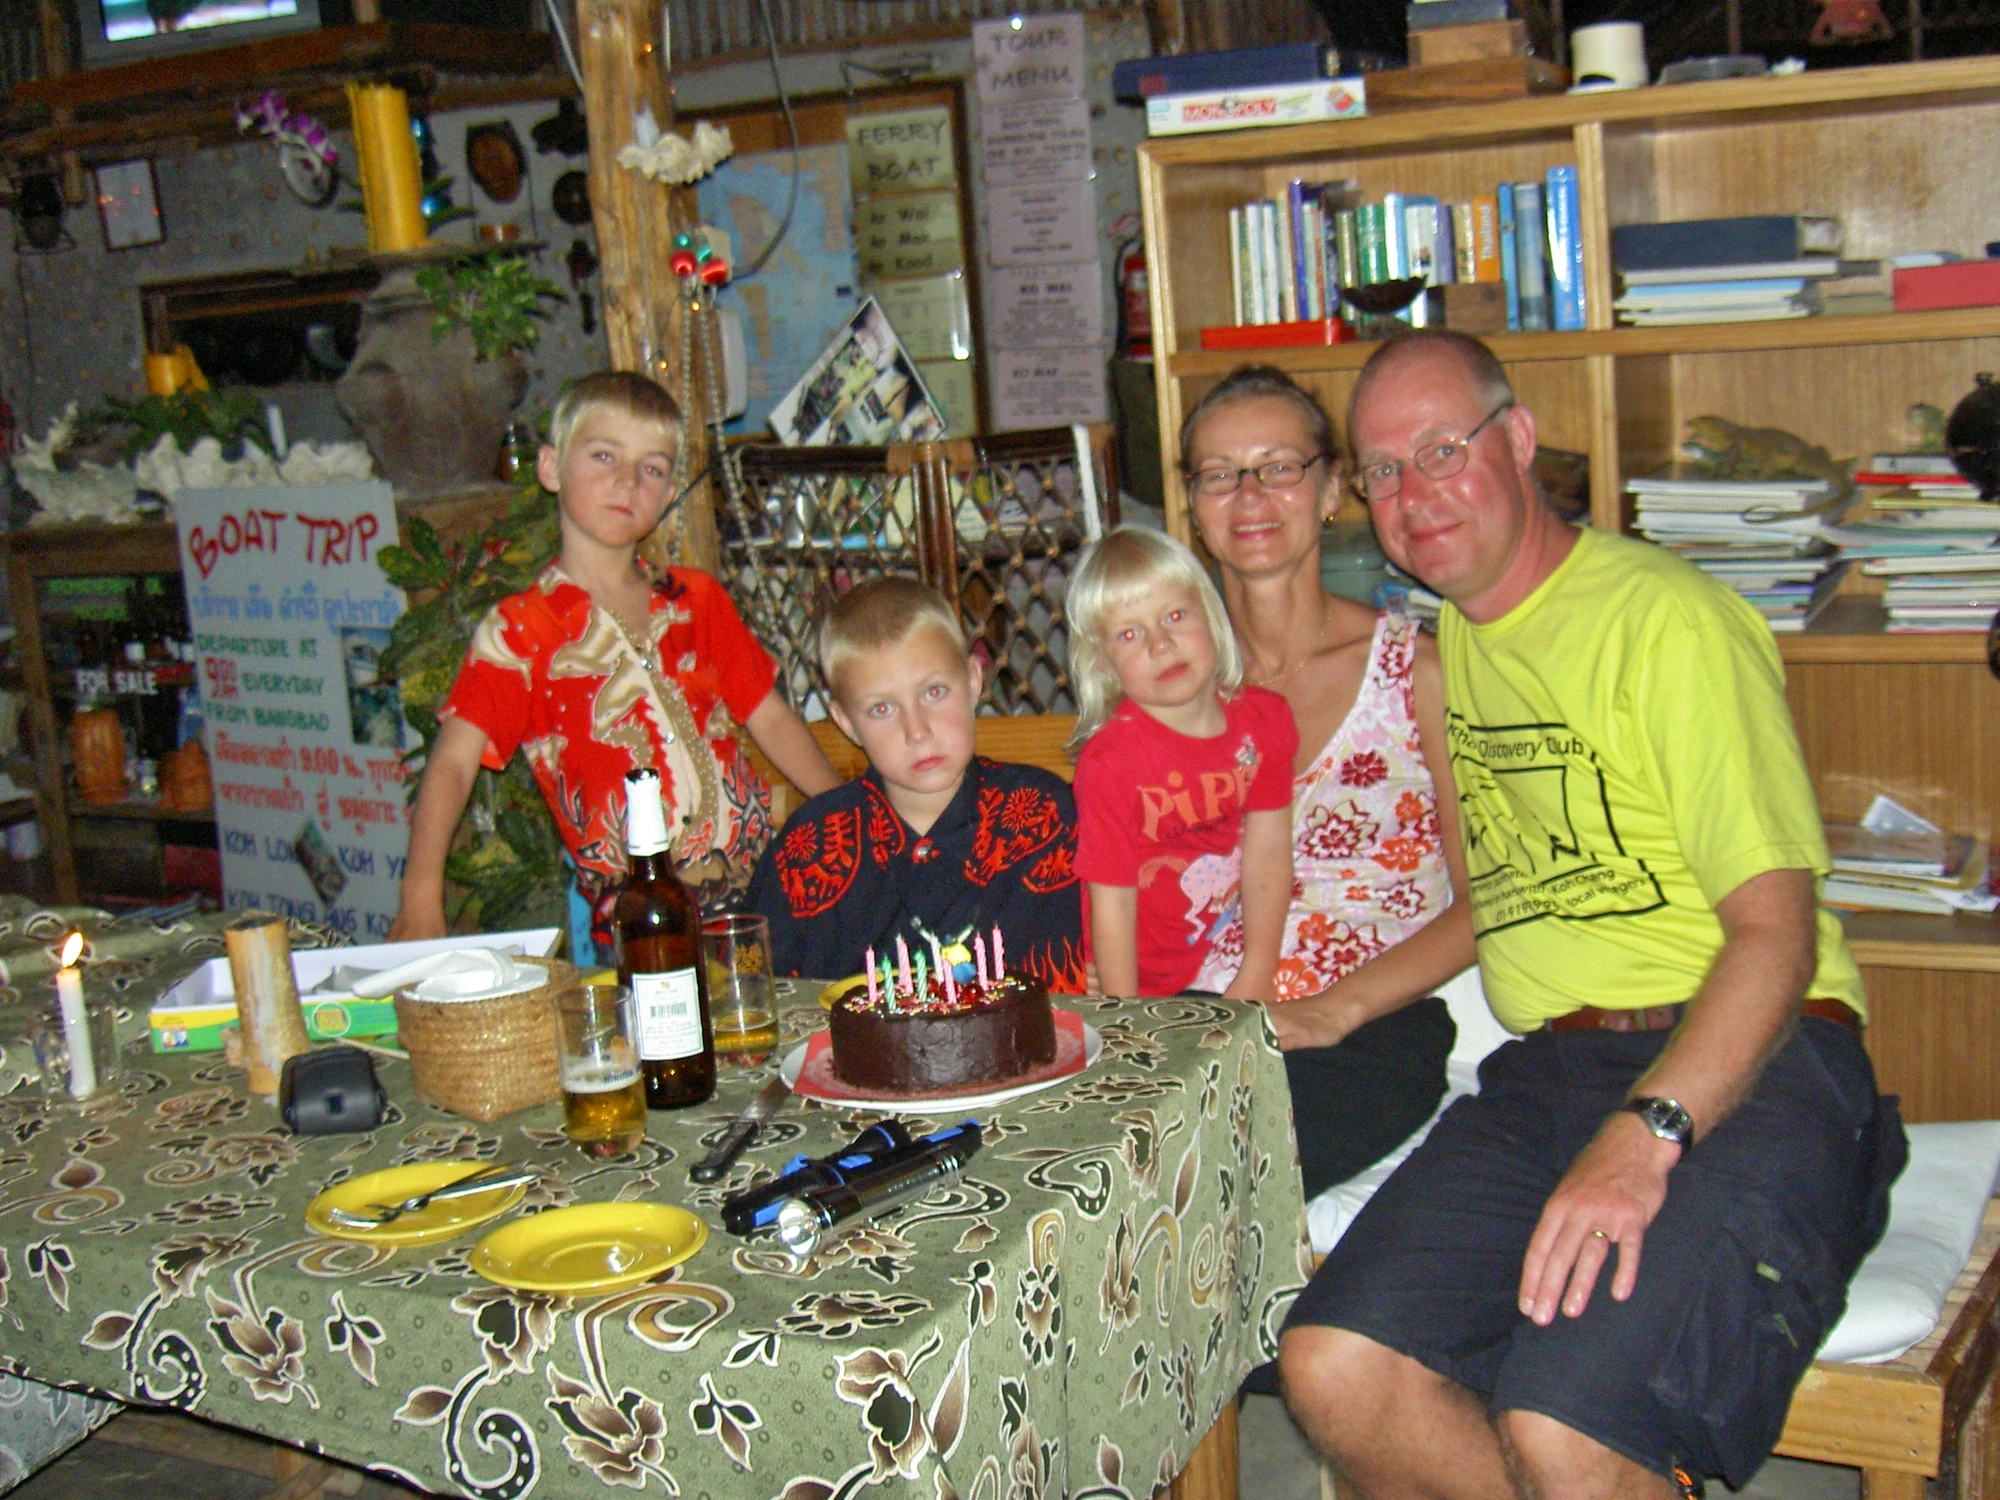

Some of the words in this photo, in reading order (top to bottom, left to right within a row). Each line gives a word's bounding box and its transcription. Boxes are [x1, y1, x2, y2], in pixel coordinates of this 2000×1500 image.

[991, 64, 1073, 90] MENU
[857, 117, 948, 149] FERRY
[867, 155, 941, 181] BOAT
[1479, 204, 1493, 260] Thailand
[189, 508, 288, 581] BOAT
[295, 511, 380, 567] TRIP
[196, 634, 288, 658] DEPARTURE
[300, 638, 317, 657] AT
[114, 669, 158, 695] SALE
[1478, 739, 1543, 762] Discovery
[338, 846, 374, 876] KOH
